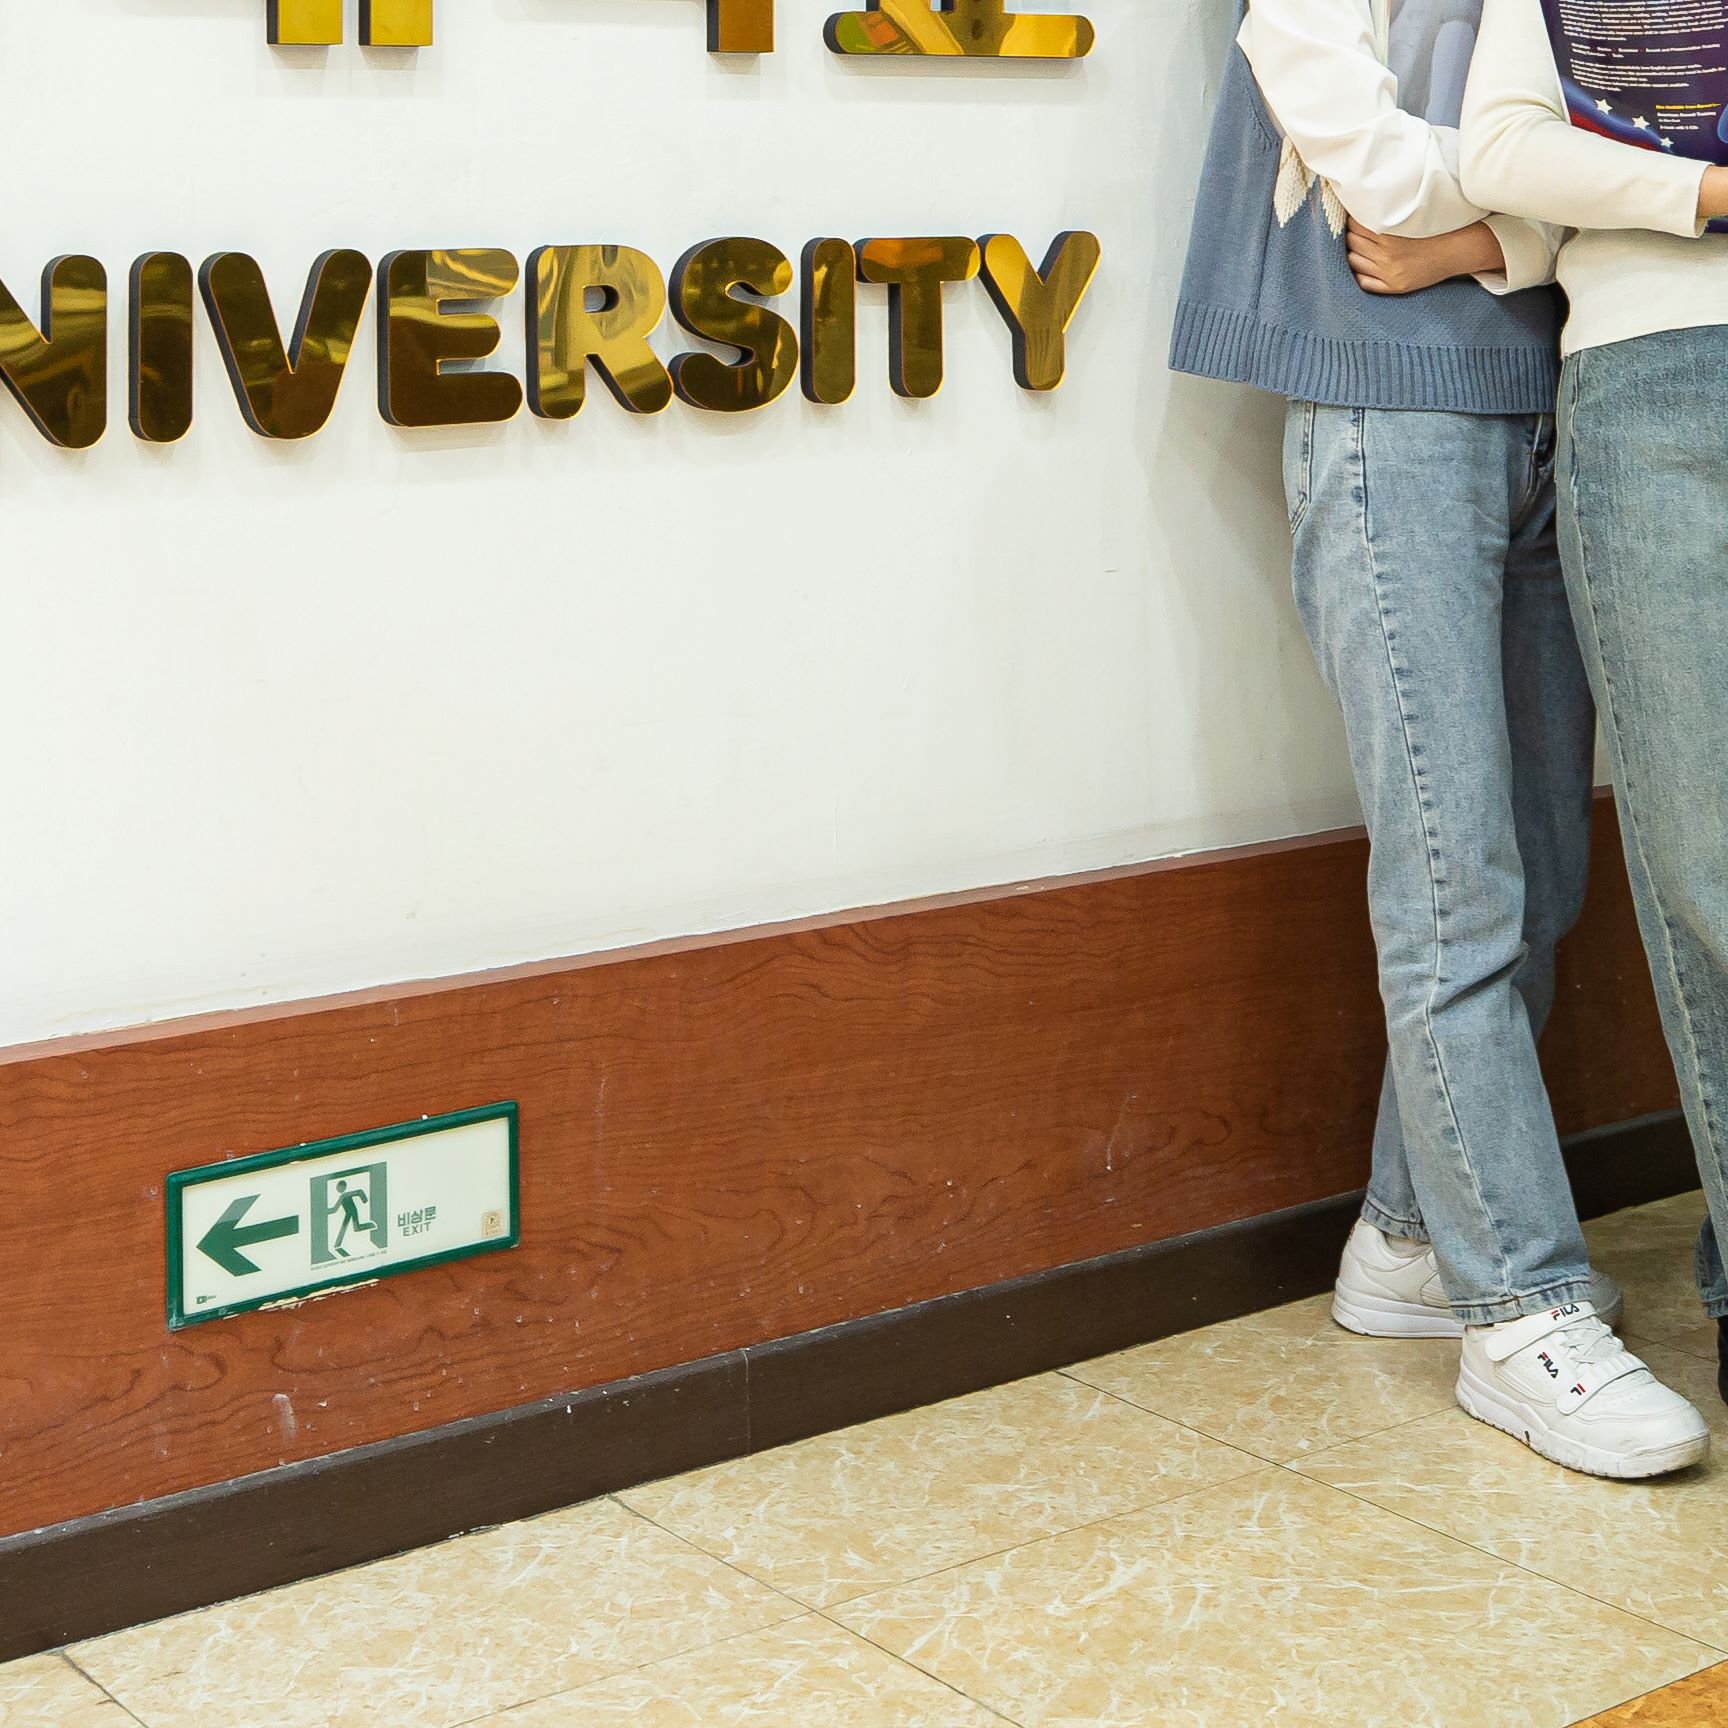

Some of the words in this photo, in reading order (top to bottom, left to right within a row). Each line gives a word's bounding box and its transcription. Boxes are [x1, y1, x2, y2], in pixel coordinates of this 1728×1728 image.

[397, 1206, 437, 1228] 비상문
[403, 1222, 432, 1237] EXIT
[1550, 1303, 1580, 1321] FILA
[1537, 1351, 1559, 1379] FILA
